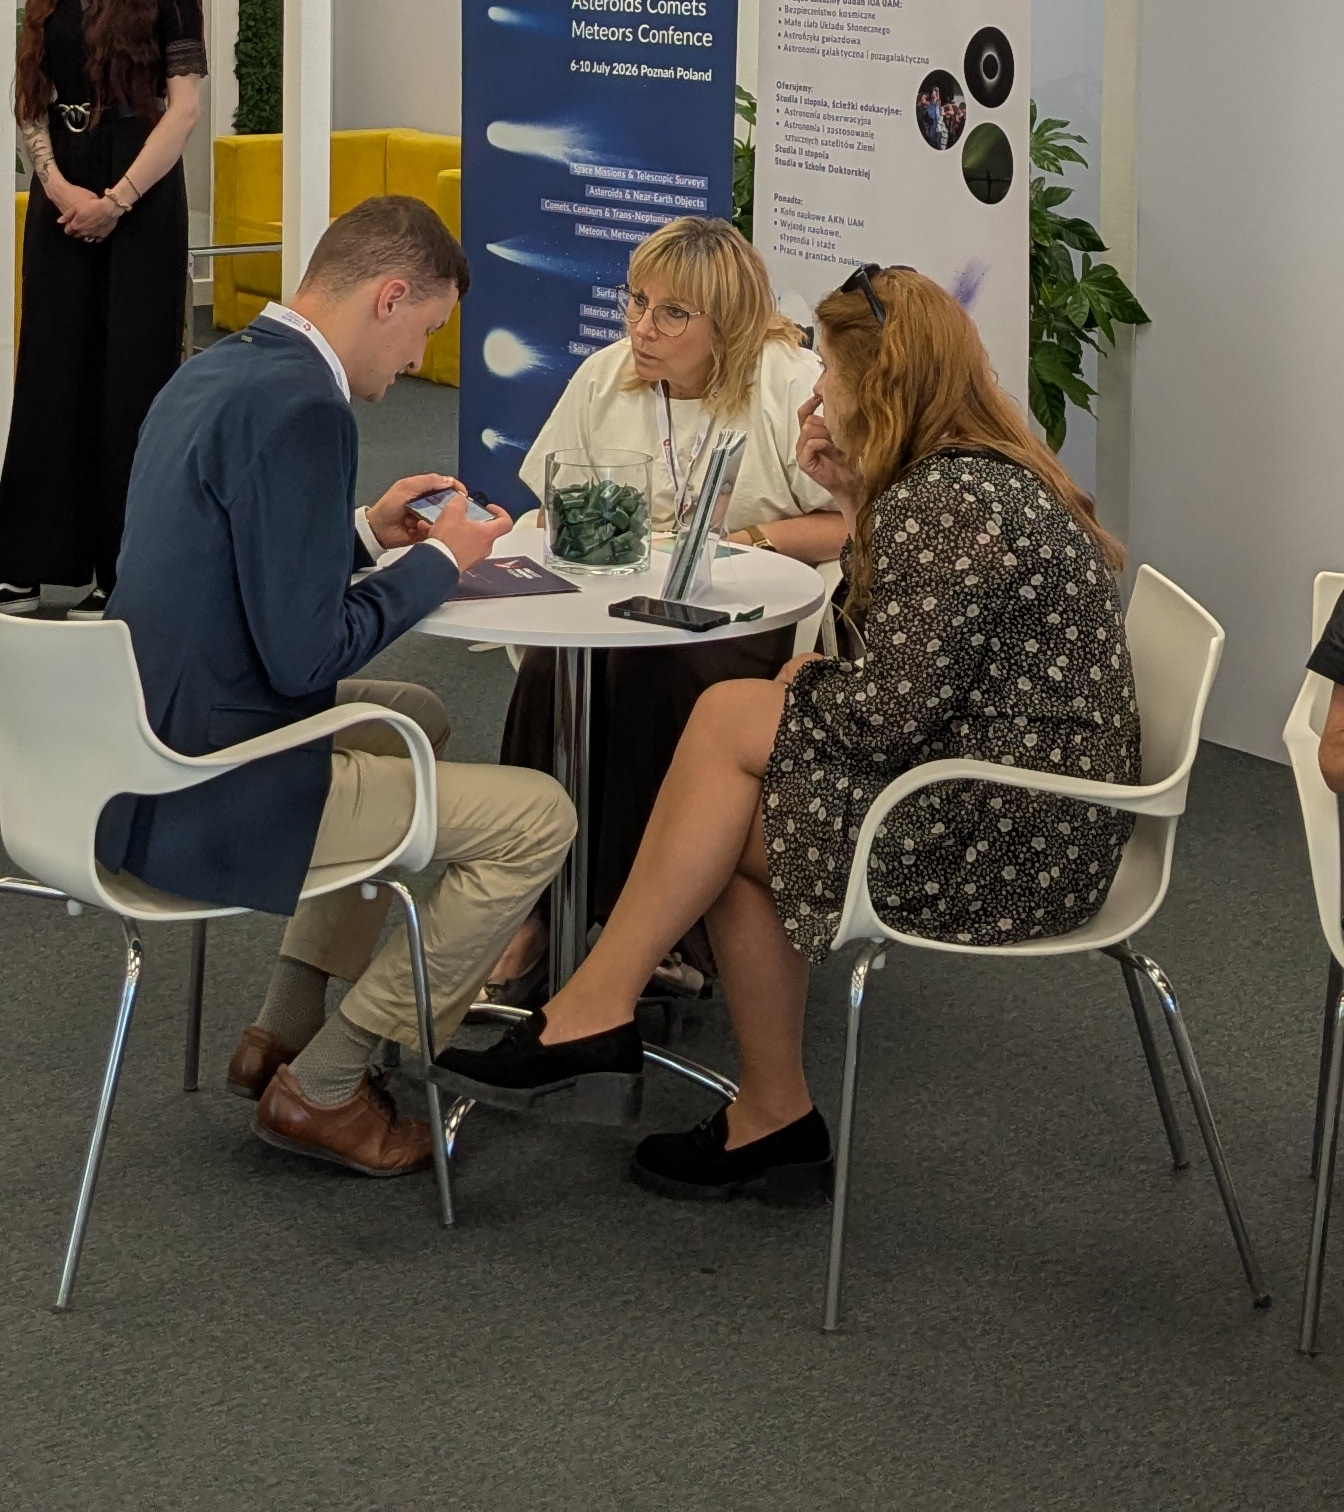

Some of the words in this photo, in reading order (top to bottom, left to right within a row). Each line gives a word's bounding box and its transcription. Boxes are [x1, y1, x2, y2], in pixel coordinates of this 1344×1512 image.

[571, 19, 633, 42] Meteors
[638, 24, 713, 47] Confence
[570, 60, 591, 72] 6-10
[592, 62, 611, 76] July
[612, 63, 638, 76] 2026
[640, 65, 674, 79] Poznań
[677, 67, 712, 81] Poland
[573, 165, 593, 175] Space
[594, 167, 626, 178] Missions
[628, 169, 633, 178] &
[636, 171, 673, 184] Telescopic
[675, 176, 705, 188] Surveys
[589, 186, 622, 198] Asteroids
[625, 190, 630, 199] &
[633, 192, 673, 204] Near-Earth
[675, 196, 704, 208] Objects
[573, 204, 602, 217] Centaurs
[605, 208, 610, 217] &
[611, 228, 649, 240] Meteoroid
